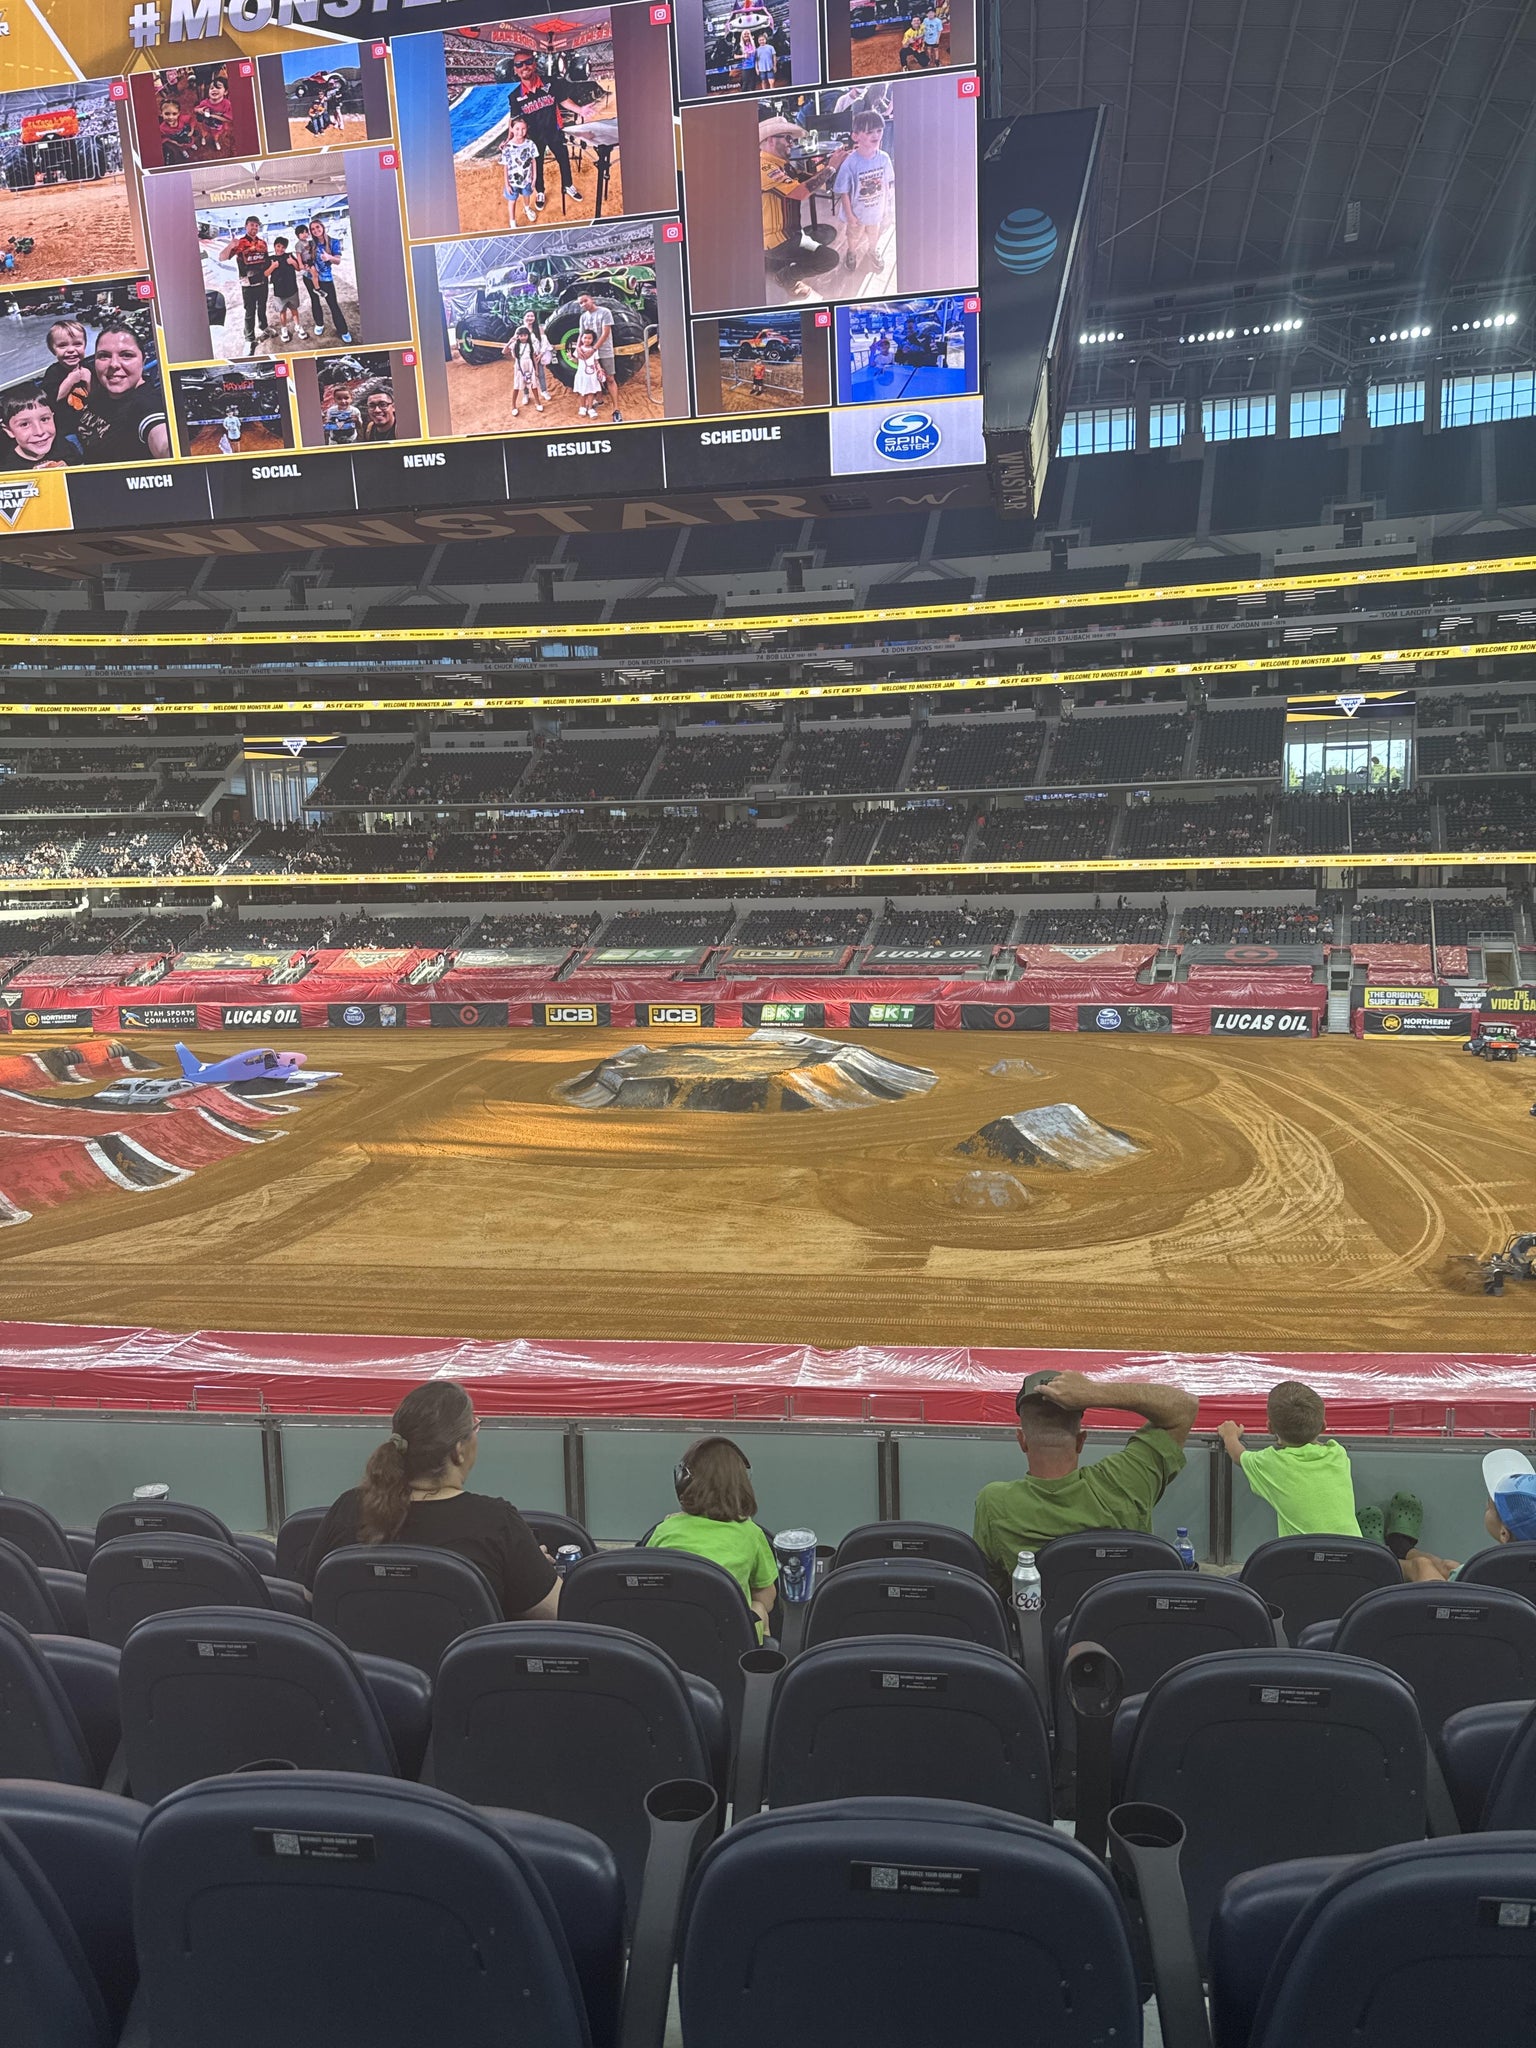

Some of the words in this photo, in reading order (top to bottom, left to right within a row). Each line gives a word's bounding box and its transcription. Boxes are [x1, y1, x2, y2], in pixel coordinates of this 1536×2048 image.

[129, 0, 438, 48] #MON
[700, 426, 781, 445] SCHEDULE
[884, 435, 929, 445] SPIN
[546, 439, 612, 458] RESULTS
[885, 444, 930, 453] MASTER
[403, 453, 446, 468] NEWS
[252, 464, 302, 480] SOCIAL
[126, 475, 173, 490] WATCH
[997, 451, 1027, 510] WINSTAR
[1058, 634, 1090, 642] STAUBACH
[1475, 646, 1508, 654] WELCOME
[1260, 660, 1290, 668] WELCOME
[875, 950, 947, 958] LUCAS
[1514, 990, 1530, 1000] THE
[1491, 998, 1520, 1010] VIDEO
[224, 1010, 273, 1024] LUCAS
[551, 1008, 593, 1022] JCB
[653, 1008, 697, 1022] JCB
[762, 1005, 804, 1018] BKT
[870, 1006, 914, 1019] BKT
[1214, 1014, 1276, 1030] LUCAS
[1404, 1017, 1452, 1025] NORTHERN
